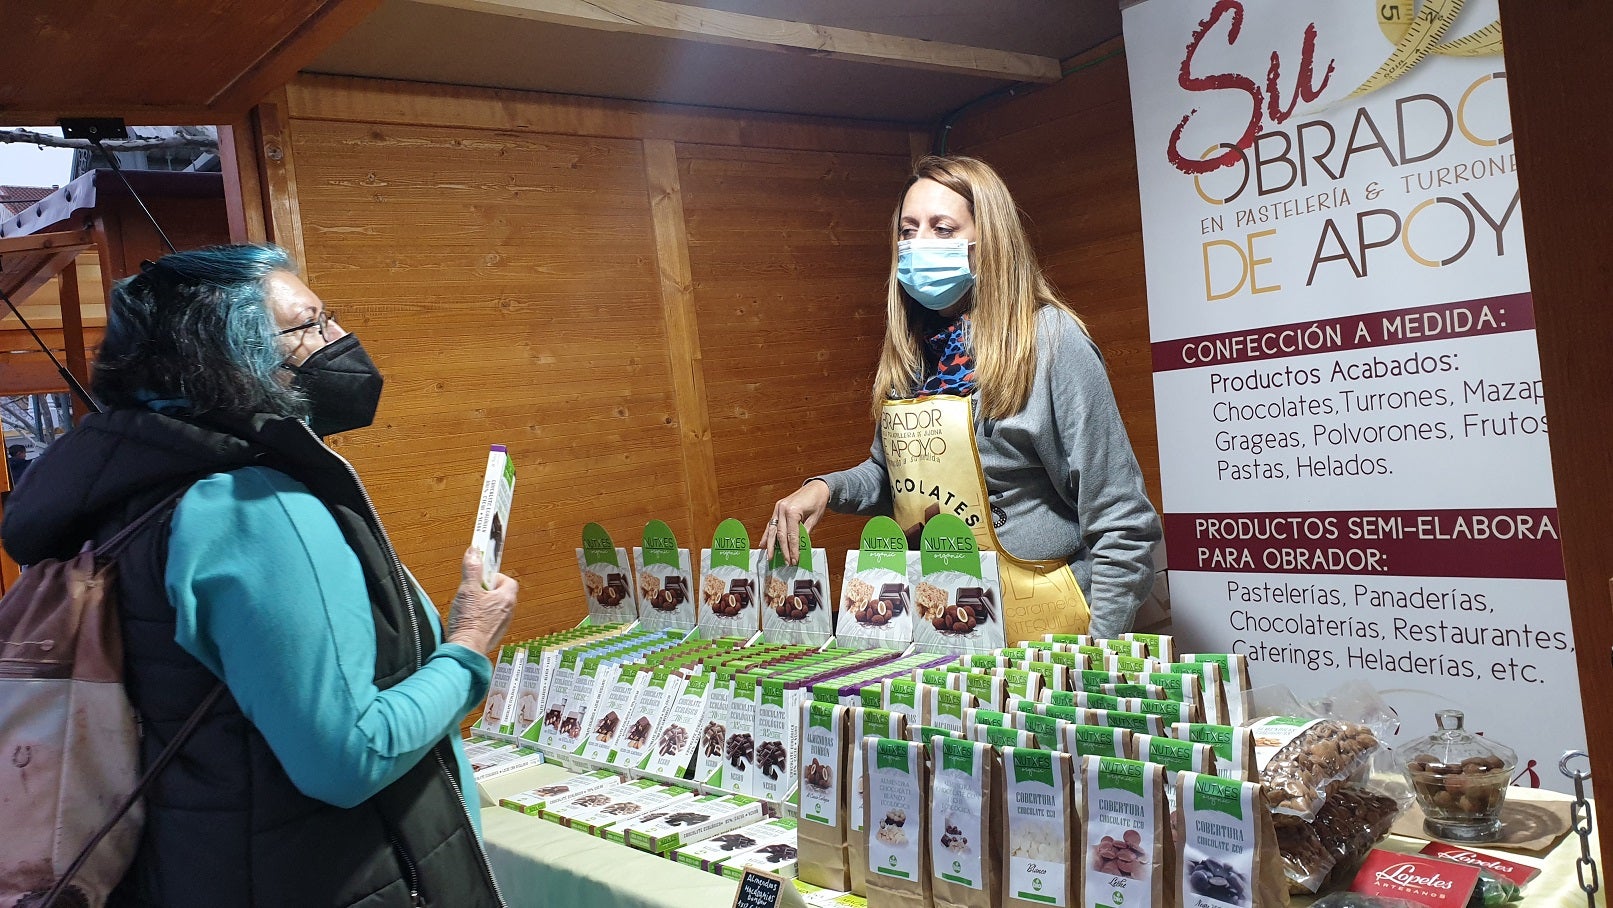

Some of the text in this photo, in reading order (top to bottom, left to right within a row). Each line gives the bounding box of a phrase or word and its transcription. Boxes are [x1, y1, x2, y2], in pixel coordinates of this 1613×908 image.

[1168, 0, 1335, 174] Su
[1201, 218, 1224, 235] EN
[1236, 187, 1351, 229] PASTELERÍA
[1365, 181, 1384, 200] &
[1202, 190, 1520, 302] DE APOY
[1181, 305, 1507, 364] CONFECCIÓN A MEDIDA:
[1210, 351, 1459, 393] Productos Acabados:
[1215, 430, 1306, 455] Grageas,
[1314, 418, 1454, 447] Polvorones,
[891, 436, 947, 458] APOYO
[1217, 454, 1393, 482] Pastas, Helados.
[890, 478, 980, 527] COLATES
[1196, 515, 1558, 540] PRODUCTOS SEMI-ELABORA
[583, 537, 611, 549] NUTXES
[643, 537, 674, 548] NUTXES
[714, 537, 746, 549] NUTXES
[863, 537, 904, 550] NUTXES
[924, 537, 973, 550] NUTXES
[933, 553, 965, 565] organic
[1198, 547, 1388, 571] PARA OBRADOR:
[1227, 581, 1494, 614] Pastelerías, Panaderías,
[1229, 609, 1575, 654] Chocolaterías, Restaurantes,
[1232, 639, 1545, 685] Caterings, Heladerías, etc.
[1150, 679, 1181, 689] NUTXES
[1141, 702, 1178, 713] NUTXES
[1077, 731, 1112, 743] NUTXES
[1191, 731, 1231, 743] NUTXES
[878, 743, 907, 756] NUTXES
[943, 744, 973, 757] NUTXES
[1151, 745, 1190, 758] NUTXES
[1014, 755, 1050, 767] NUTXES
[1100, 760, 1142, 777] NUTXES
[1196, 781, 1240, 799] NUTXES
[1015, 791, 1056, 807] COBERTURA
[1017, 806, 1056, 818] CHOCOLATE ECO
[1098, 799, 1145, 818] COBERTURA
[1099, 813, 1145, 830] CHOCOLATE ECO
[1195, 819, 1244, 842] COBERTURA
[1197, 836, 1243, 855] CHOCOLATE ECO
[1026, 863, 1047, 875] Blanco
[1374, 881, 1446, 900] ARTESANOS
